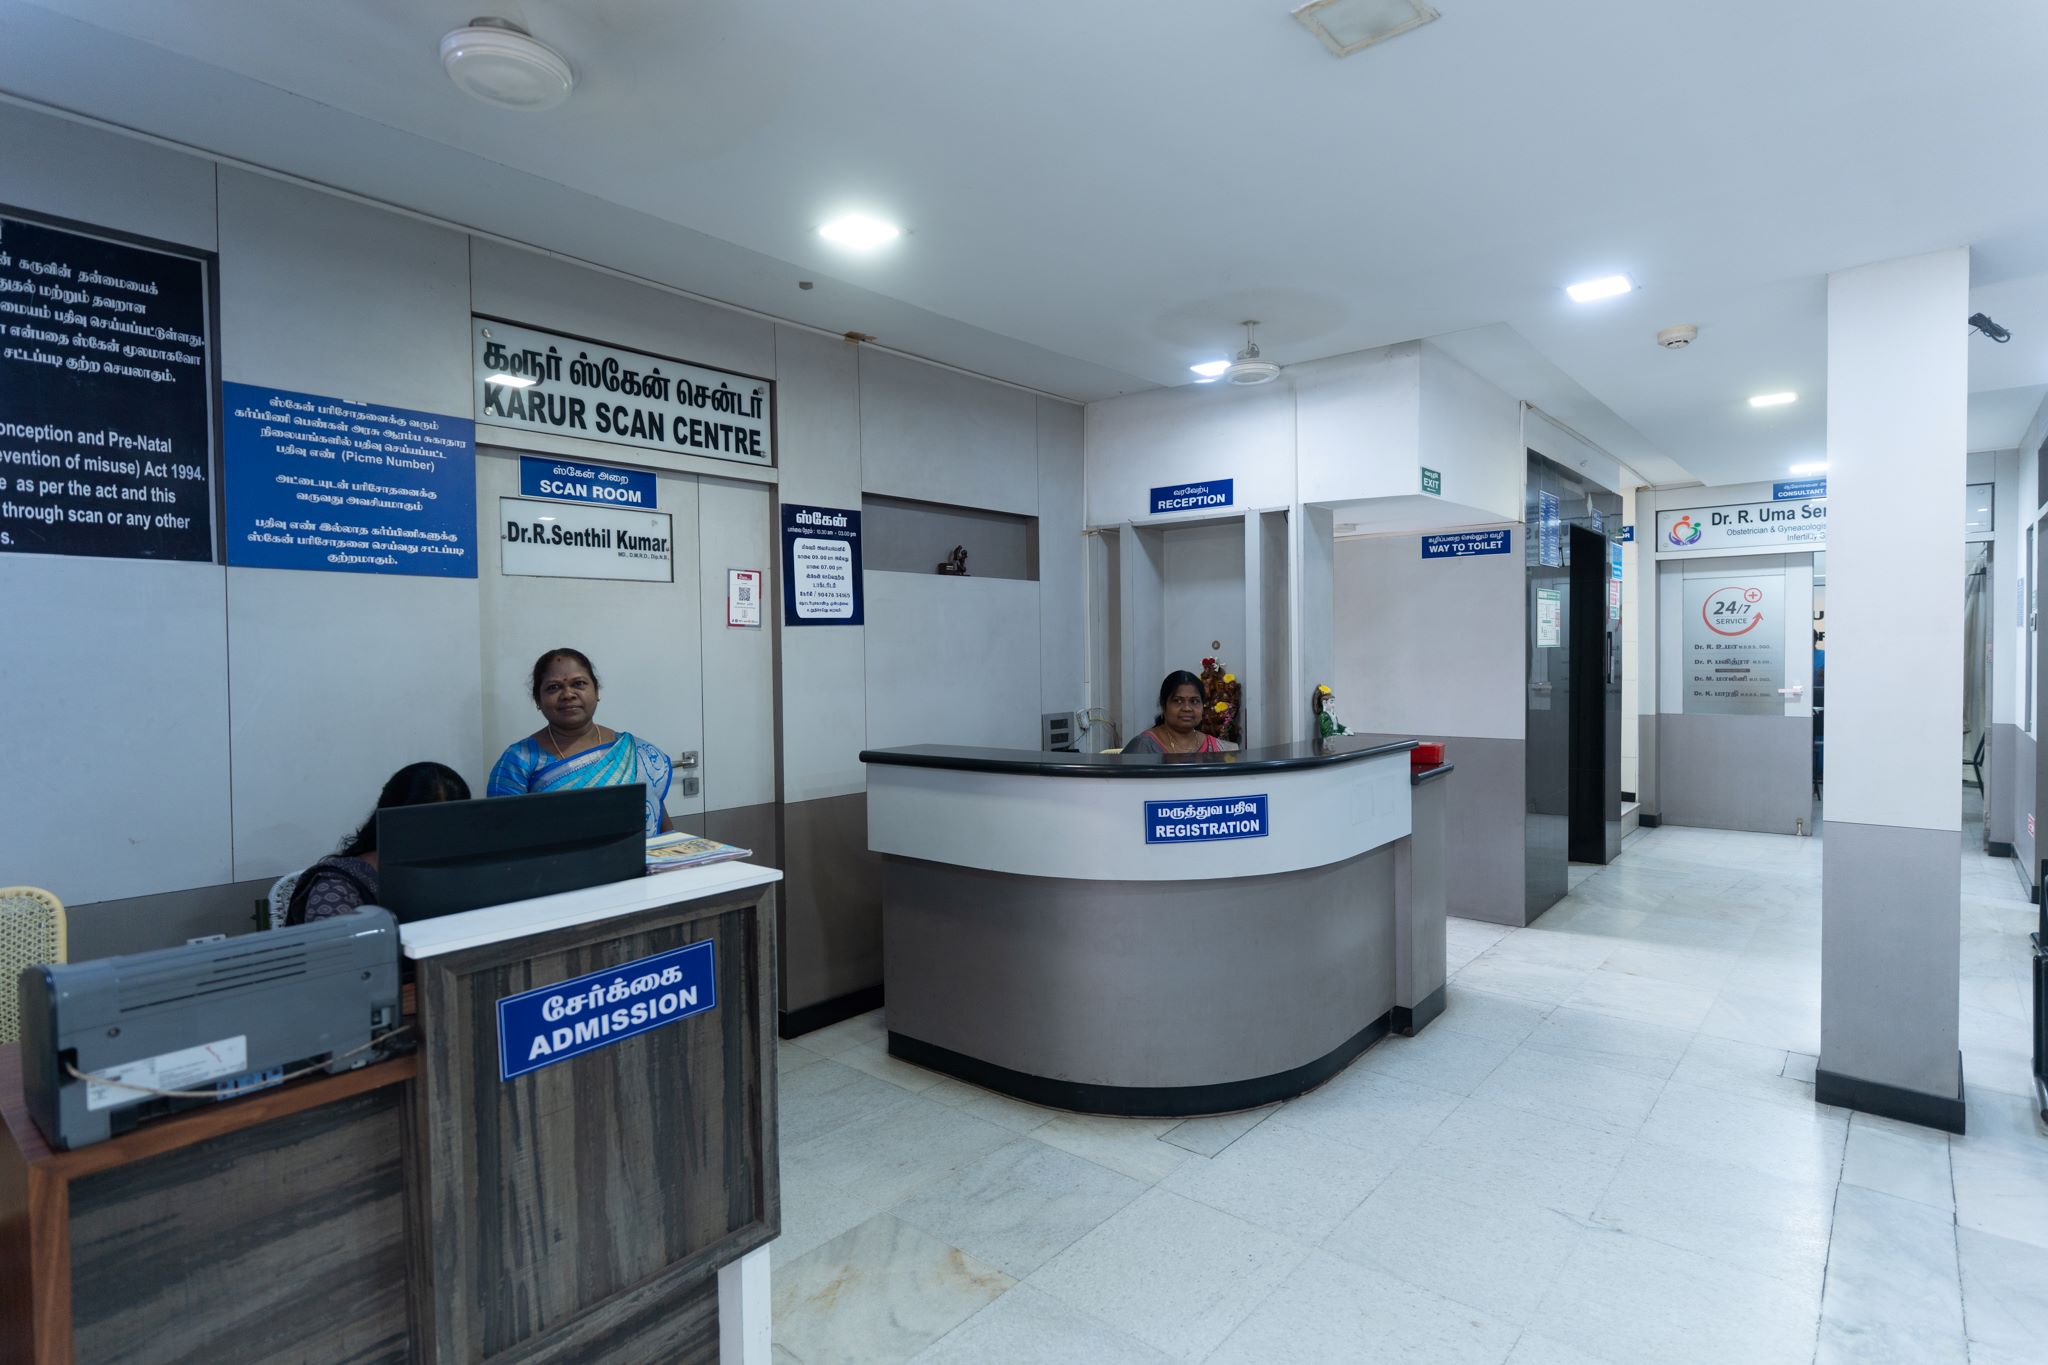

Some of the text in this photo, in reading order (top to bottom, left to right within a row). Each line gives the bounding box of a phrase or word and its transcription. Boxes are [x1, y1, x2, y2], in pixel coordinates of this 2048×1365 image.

[19, 259, 71, 278] கருவின்
[78, 270, 159, 295] தன்மையைக்
[39, 284, 90, 303] மற்றும்
[92, 295, 146, 314] தவறான
[54, 309, 87, 327] பதிவு
[90, 316, 205, 347] செய்யப்பட்டுள்ளது.
[10, 324, 69, 345] என்பதை
[72, 333, 119, 352] ஸ்கேன்
[123, 343, 200, 365] மூலமாகவோ
[4, 348, 176, 382] சட்டப்படி குற்ற செயலாகும்.
[483, 341, 763, 420] கரூர் ஸ்கேன் சென்டர்
[269, 396, 440, 431] ஸ்கேன் பரிசோதனைக்கு வரும்
[484, 382, 764, 457] KARUR SCAN CENTRE
[234, 408, 467, 448] கர்ப்பிணி பெண்கள் அரசு ஆரம்ப சுகாதார
[78, 430, 104, 446] and
[109, 431, 172, 453] Pre-Natal
[260, 425, 447, 459] நிலையங்களில் பதிவு செய்யப்பட்ட
[65, 454, 80, 470] of
[85, 456, 140, 479] misuse)
[144, 461, 168, 478] Act
[171, 463, 205, 481] 1994.
[276, 444, 435, 473] பதிவு எண் (Picme Number)
[275, 474, 438, 500] அட்டையுடன் பரிசோதனைக்கு
[553, 464, 629, 485] ஸ்கேன் அறை
[1423, 477, 1439, 489] EXIT
[16, 478, 34, 492] as
[40, 480, 64, 497] per
[68, 479, 91, 497] the
[96, 484, 118, 499] act
[121, 486, 147, 501] and
[151, 487, 176, 503] this
[296, 492, 423, 511] வருவது அவசியமாகும்
[540, 479, 642, 503] SCAN ROOM
[1158, 493, 1226, 510] RECEPTION
[1173, 485, 1209, 497] வரவேற்பு
[1778, 488, 1824, 497] CONSULTANT
[2, 501, 191, 530] through scan or any other
[796, 509, 848, 528] ஸ்கேன்
[1712, 512, 1732, 526] Dr.
[1738, 510, 1753, 524] R.
[1759, 508, 1795, 522] Uma
[255, 517, 458, 542] பதிவு எண் இல்லாத கர்ப்பிணிகளுக்கு
[507, 521, 611, 549] Dr.R.Senthil
[1727, 527, 1768, 536] Obstetrician
[247, 531, 464, 556] ஸ்கேன் பரிசோதனை செய்வது சட்டப்படி
[1429, 540, 1503, 553] WAY TO TOILET
[327, 552, 398, 565] குற்றமாகும்.
[1713, 600, 1751, 615] 24/7
[1716, 617, 1747, 625] SERVICE
[1158, 801, 1256, 820] மருத்துவ பதிவு
[1156, 819, 1260, 838] REGISTRATION
[541, 965, 683, 1022] சேர்க்கை
[528, 985, 698, 1061] ADMISSION
